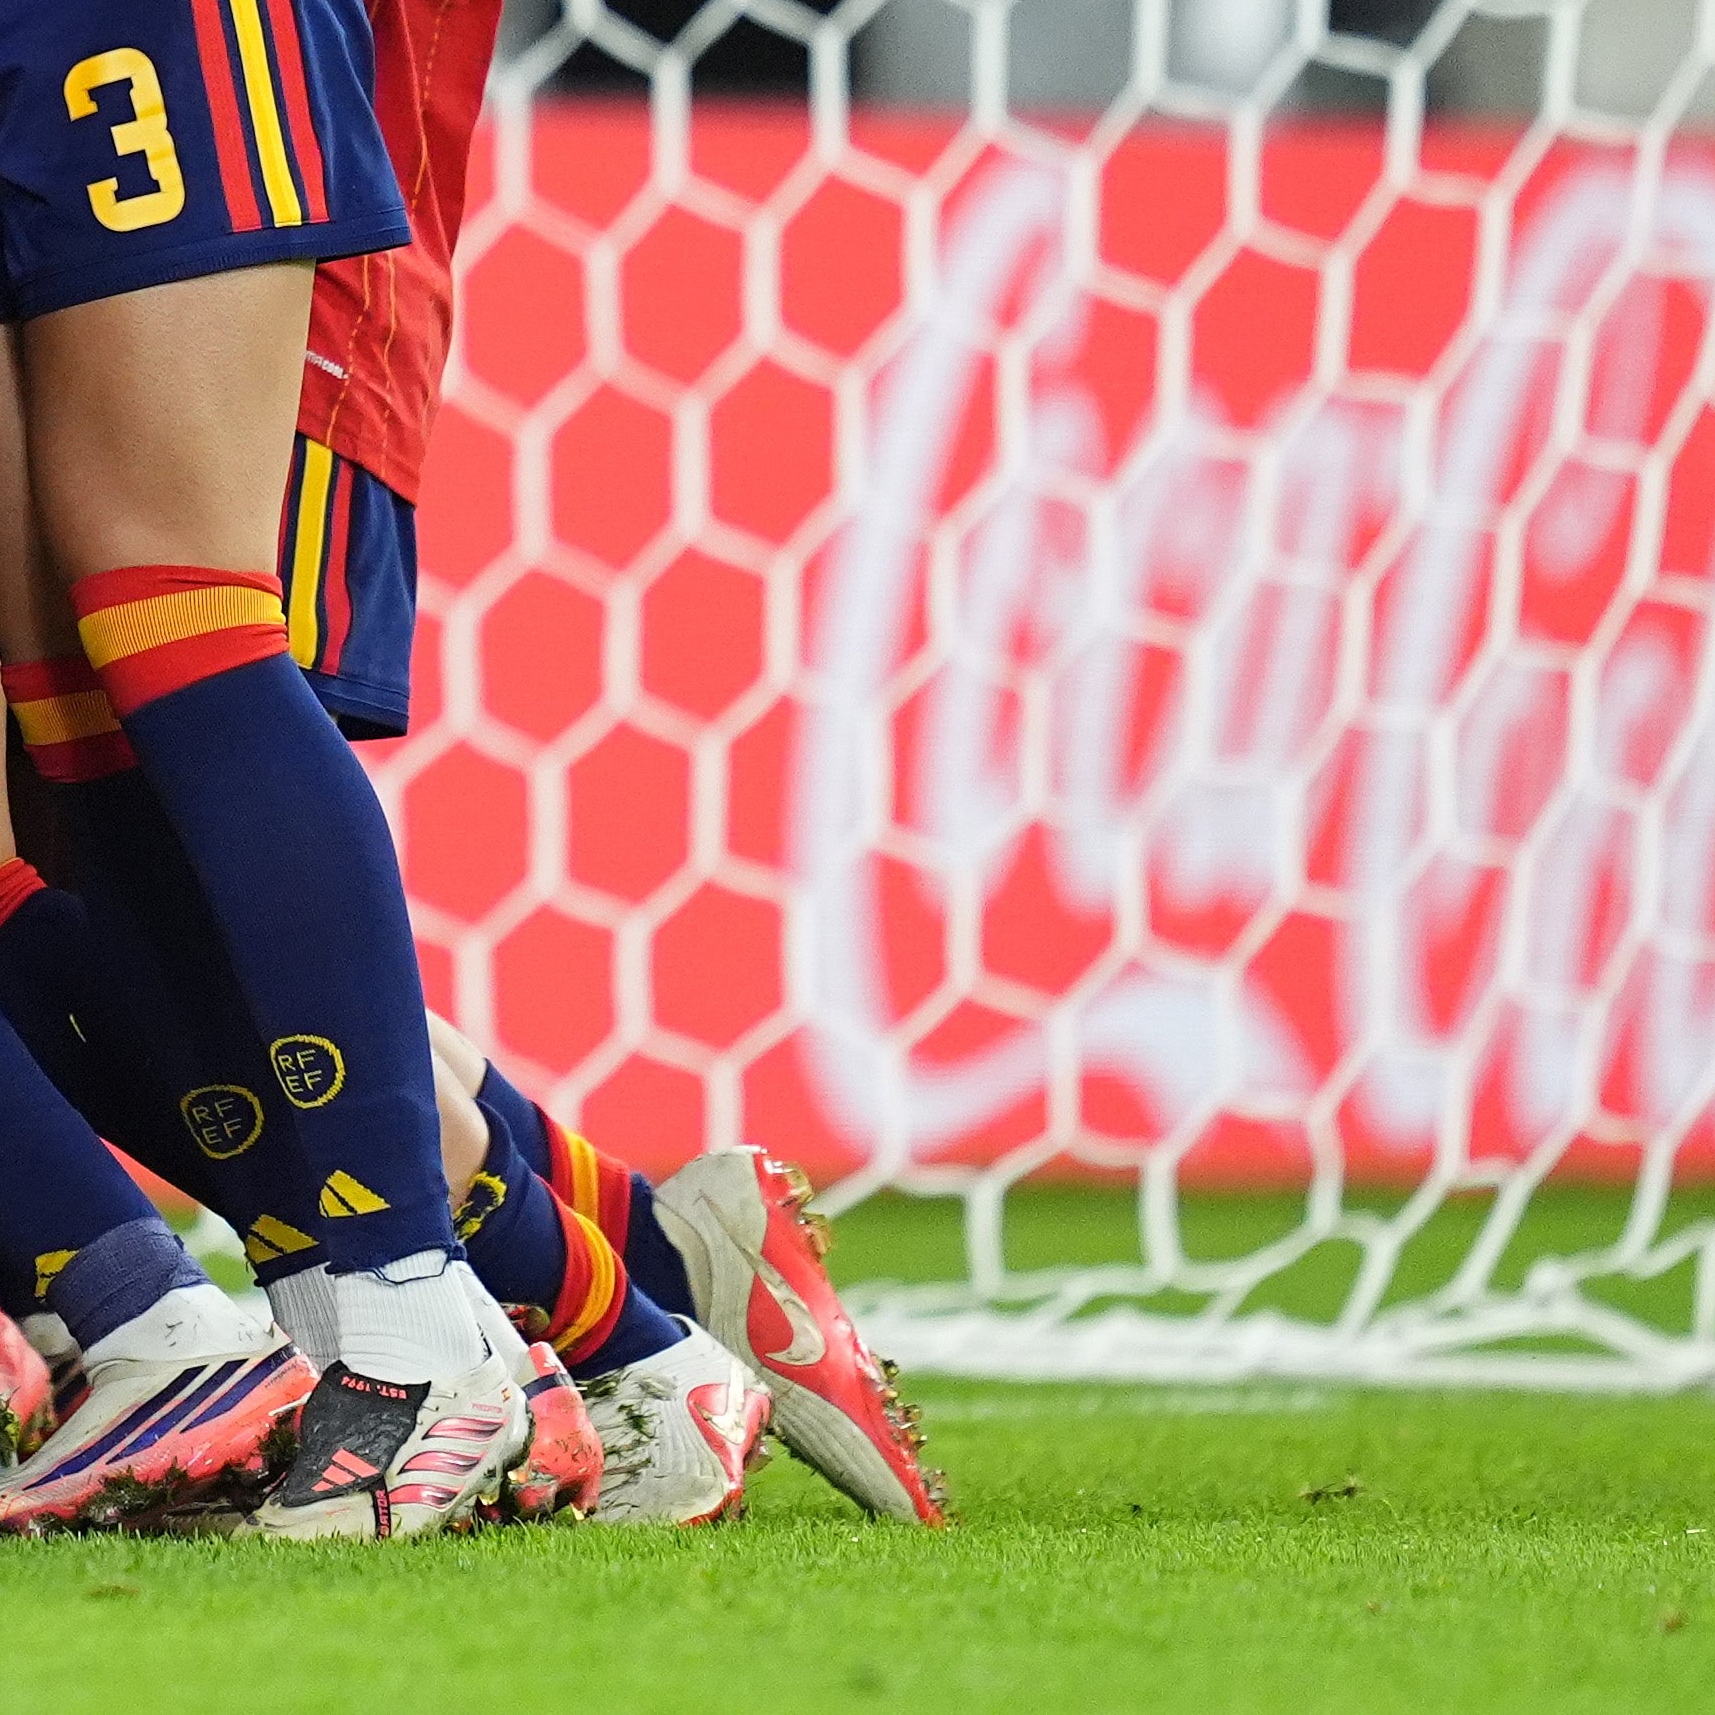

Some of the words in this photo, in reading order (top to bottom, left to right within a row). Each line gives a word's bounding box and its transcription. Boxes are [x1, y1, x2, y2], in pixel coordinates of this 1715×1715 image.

[62, 46, 187, 233] 3
[340, 1375, 371, 1393] 1994
[375, 1385, 409, 1401] EST.
